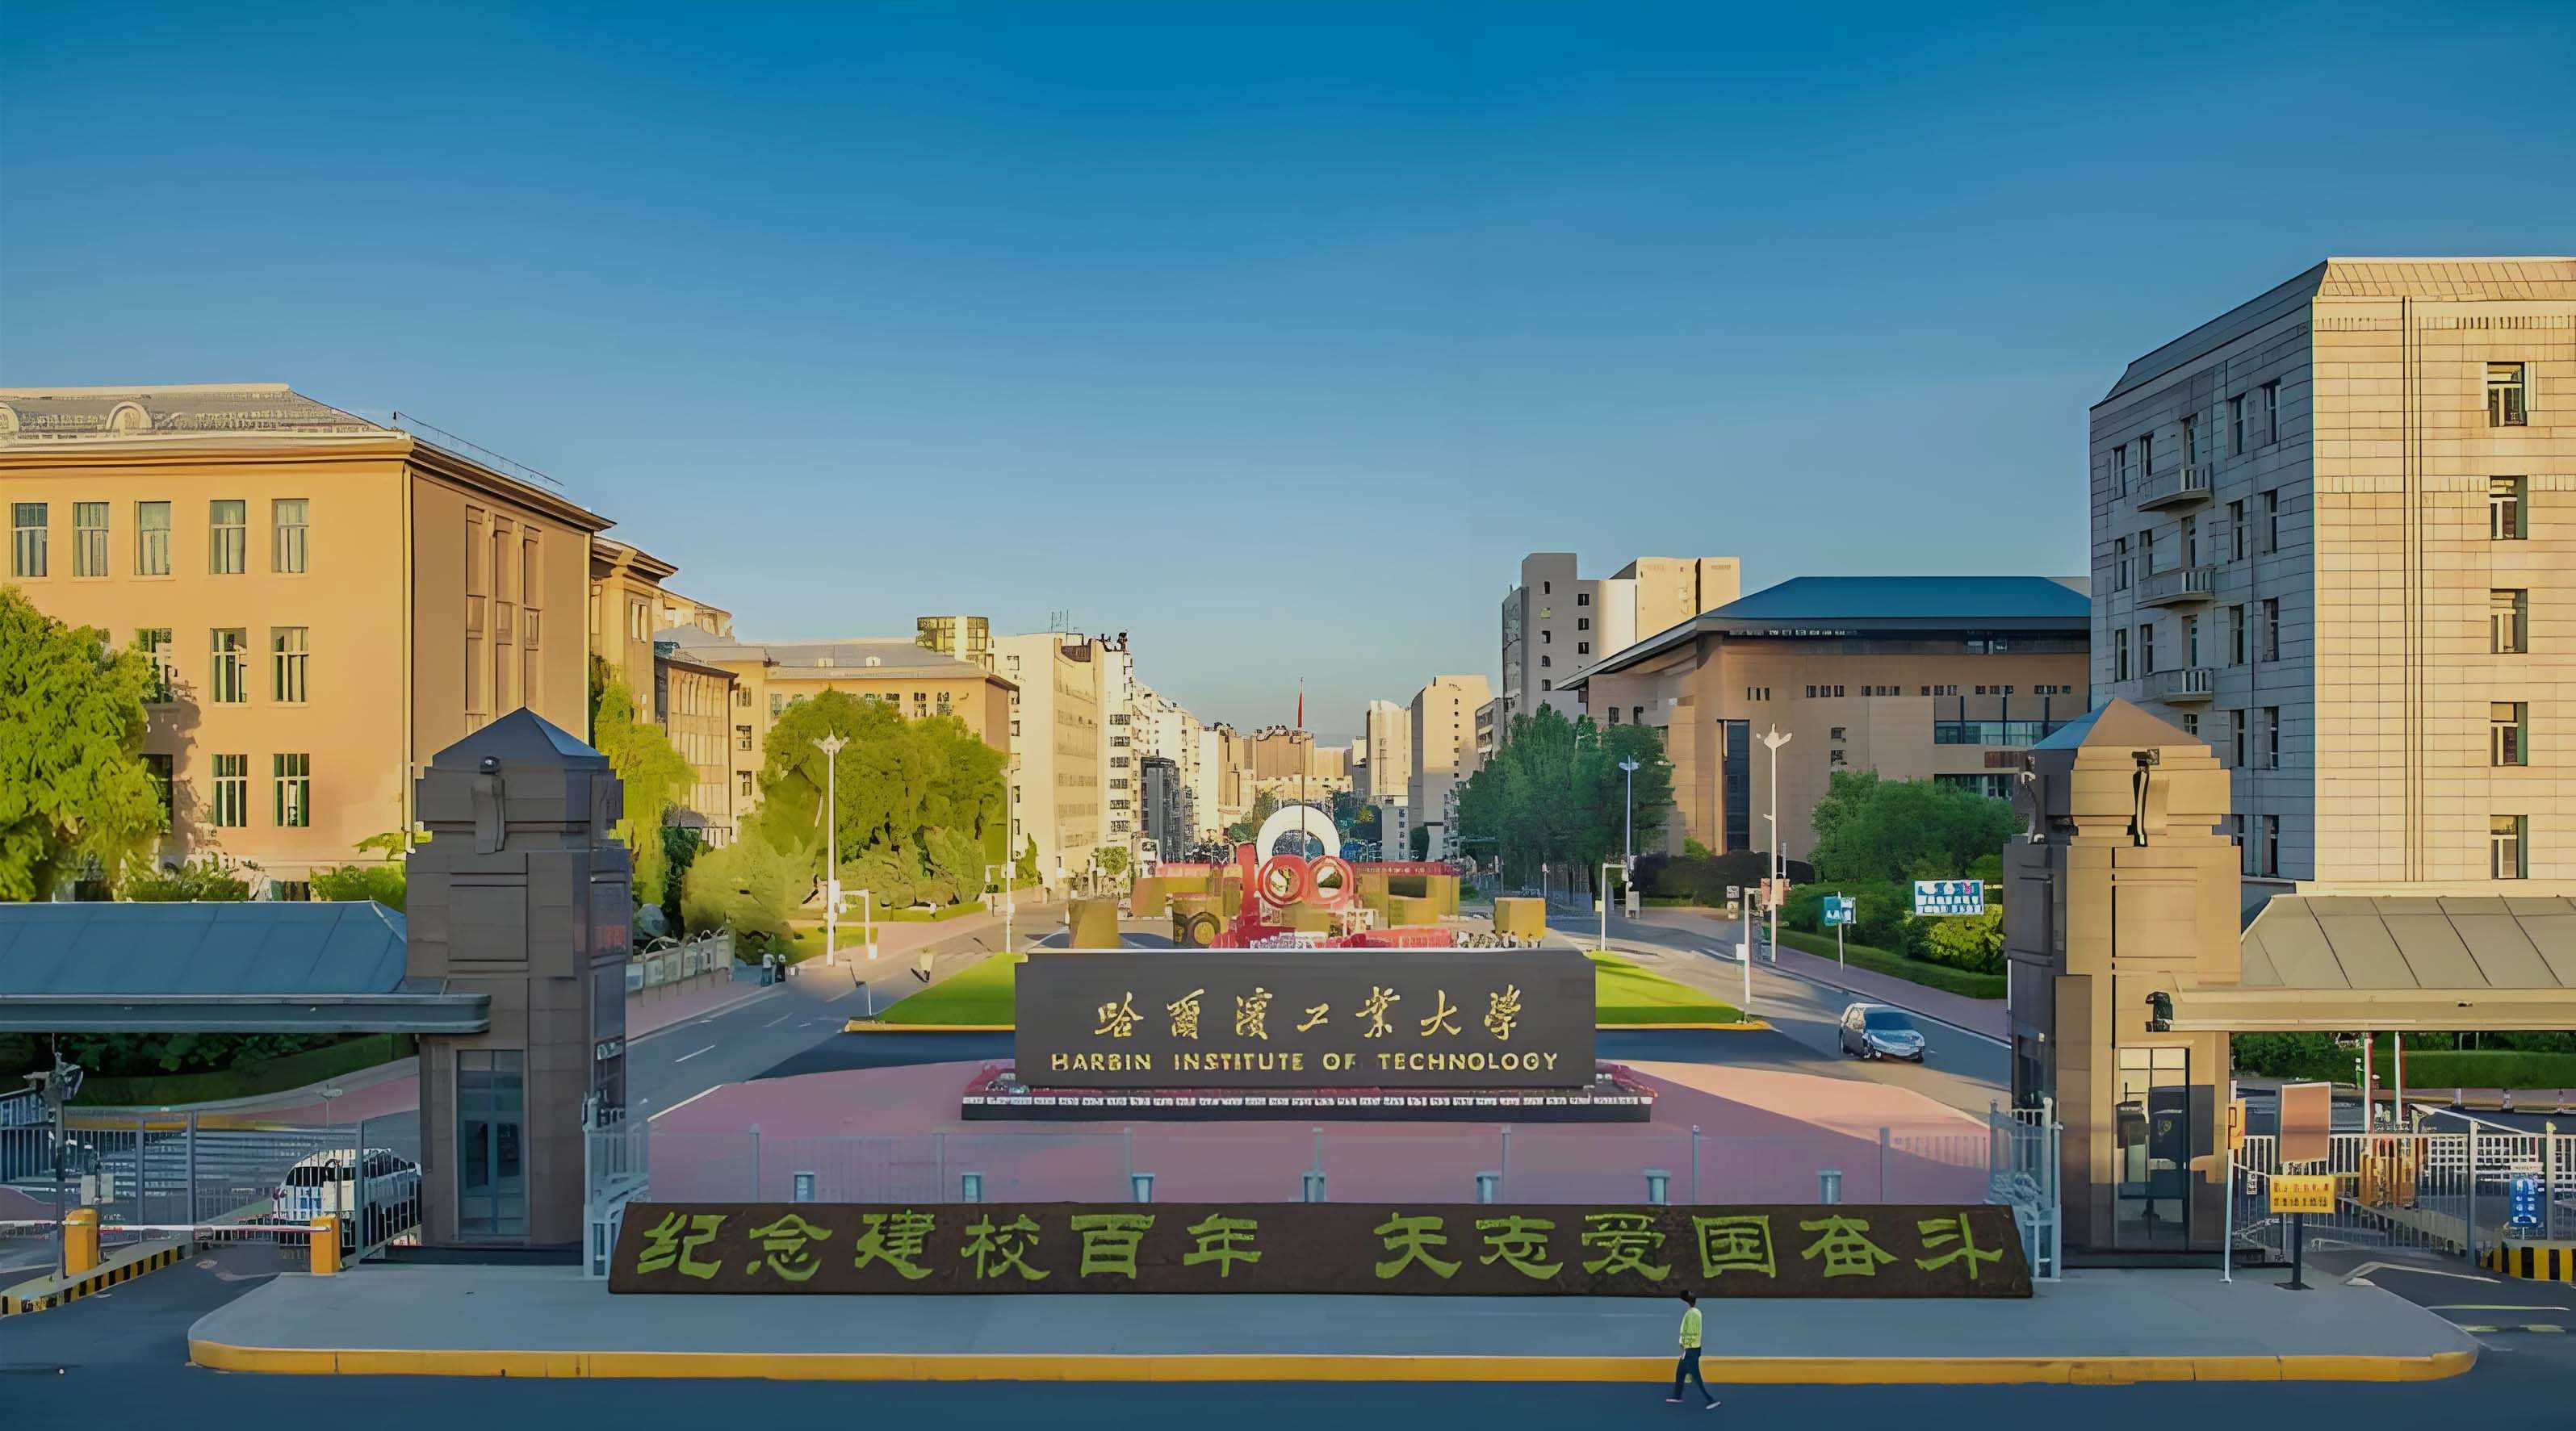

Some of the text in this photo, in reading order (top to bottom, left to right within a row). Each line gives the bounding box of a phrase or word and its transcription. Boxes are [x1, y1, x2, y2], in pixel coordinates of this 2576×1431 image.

[1051, 1052, 1559, 1072] HARBIN INSTITUTE OF TECHNOLOGY
[636, 1209, 1262, 1281] 纪念建校百年
